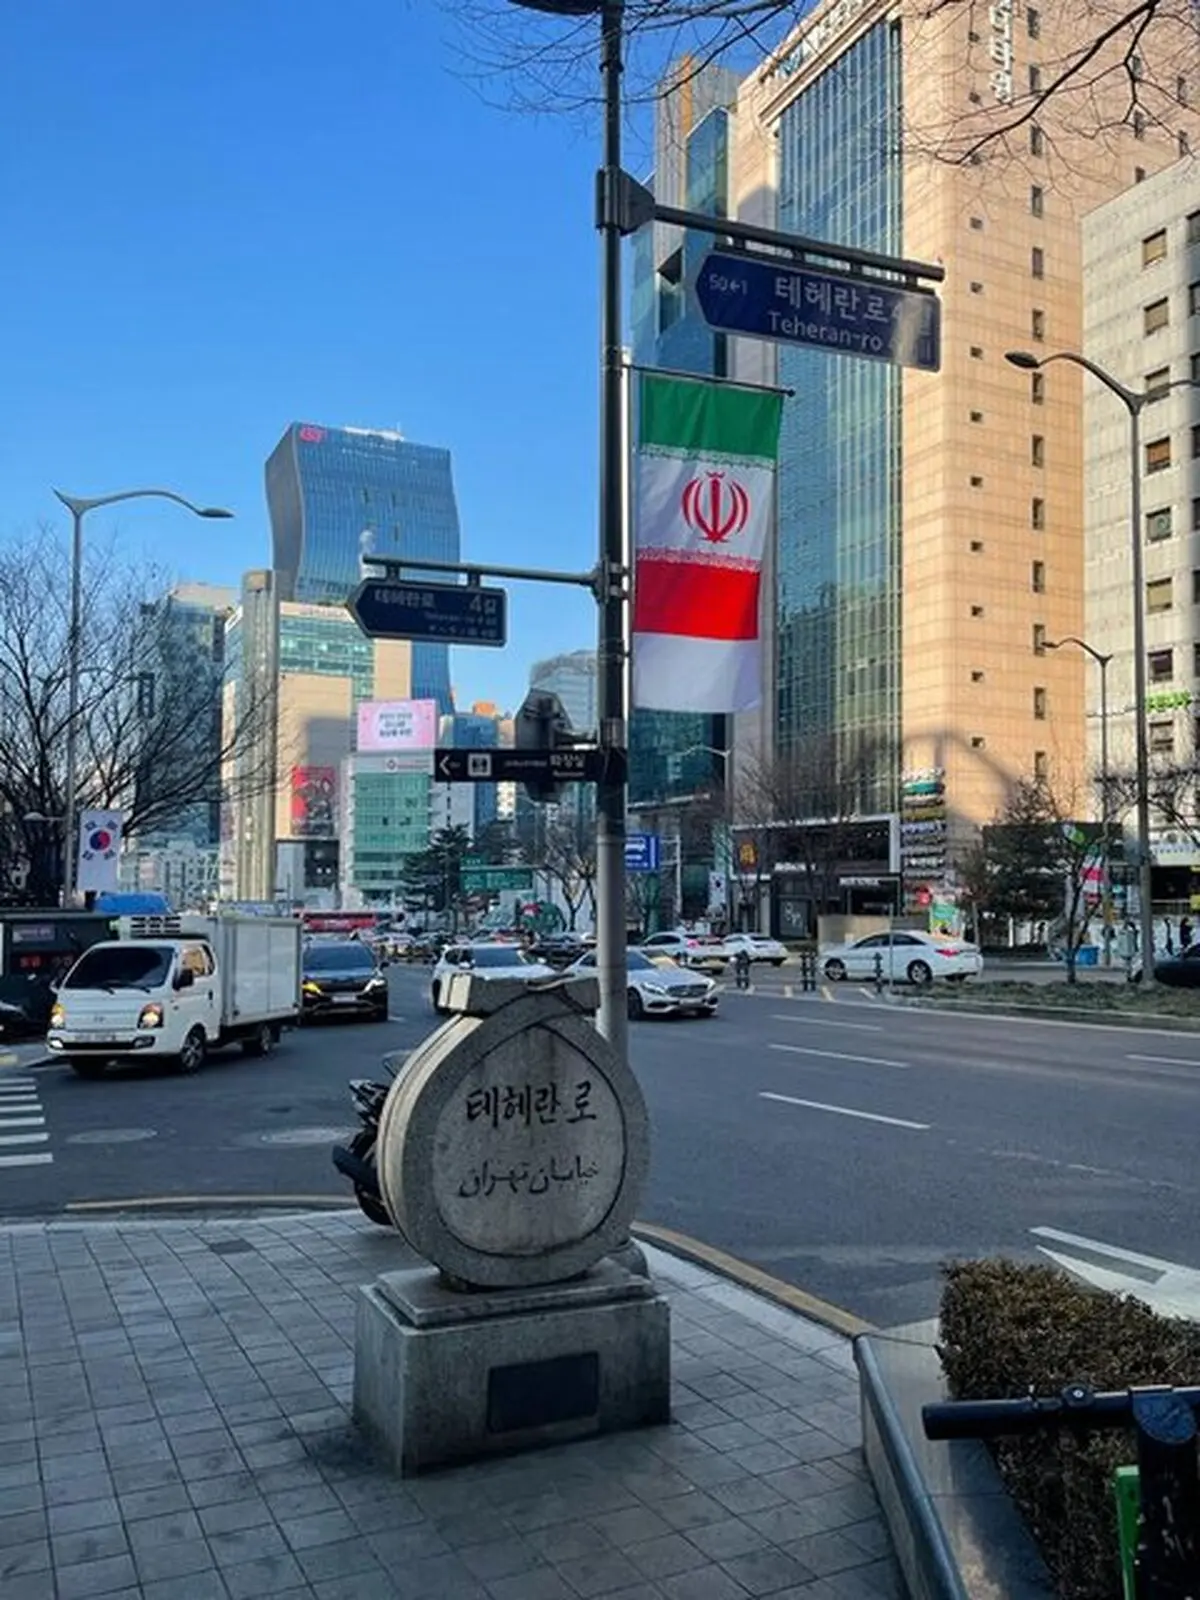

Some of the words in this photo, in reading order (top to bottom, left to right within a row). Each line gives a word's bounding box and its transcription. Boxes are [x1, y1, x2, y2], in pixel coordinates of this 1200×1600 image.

[774, 275, 889, 323] 테헤란로
[767, 310, 884, 351] Teheran-ro
[465, 1080, 598, 1128] 테헤란로
[457, 1159, 530, 1198] تهران
